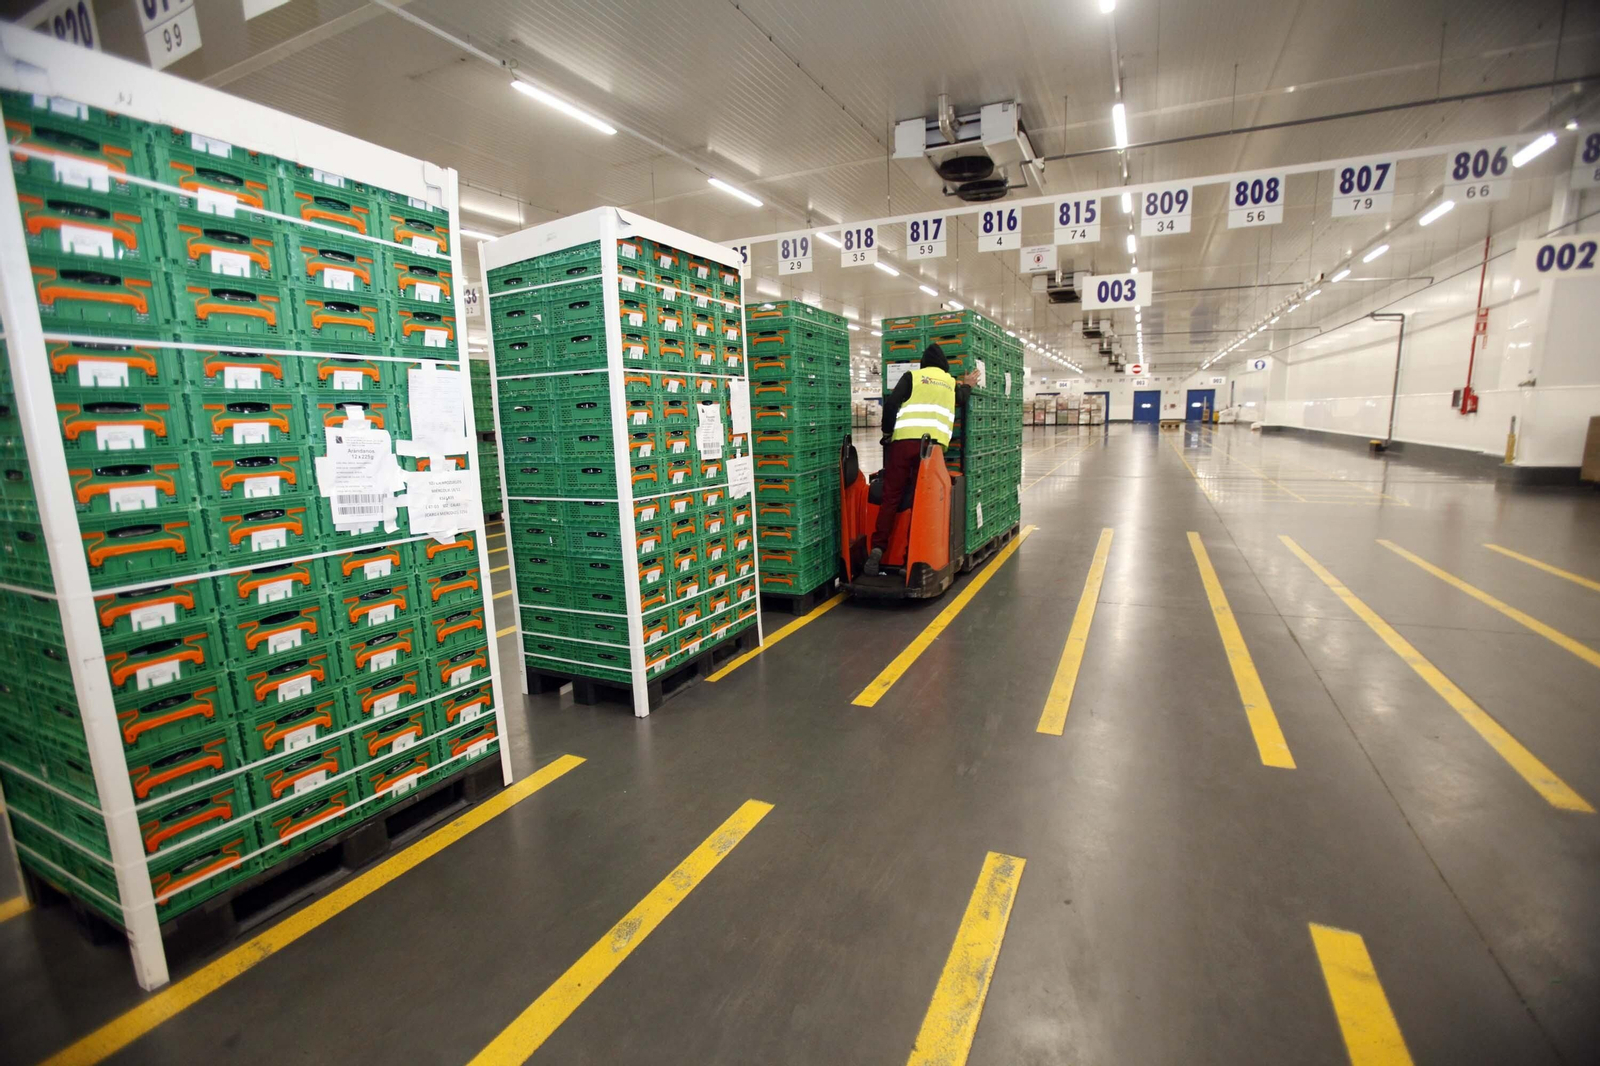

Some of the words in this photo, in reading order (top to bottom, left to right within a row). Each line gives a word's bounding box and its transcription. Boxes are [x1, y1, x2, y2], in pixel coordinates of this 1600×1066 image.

[1452, 147, 1508, 181] 806
[1234, 177, 1280, 207] 808
[1339, 163, 1392, 195] 807
[1058, 199, 1097, 226] 815
[1145, 189, 1189, 216] 809
[910, 218, 943, 243] 817
[982, 208, 1018, 234] 816
[781, 237, 809, 260] 819
[844, 227, 874, 251] 818
[996, 236, 1003, 246] 4
[732, 246, 747, 264] 5
[1536, 240, 1599, 273] 002
[464, 288, 477, 304] 36
[1097, 278, 1137, 304] 003
